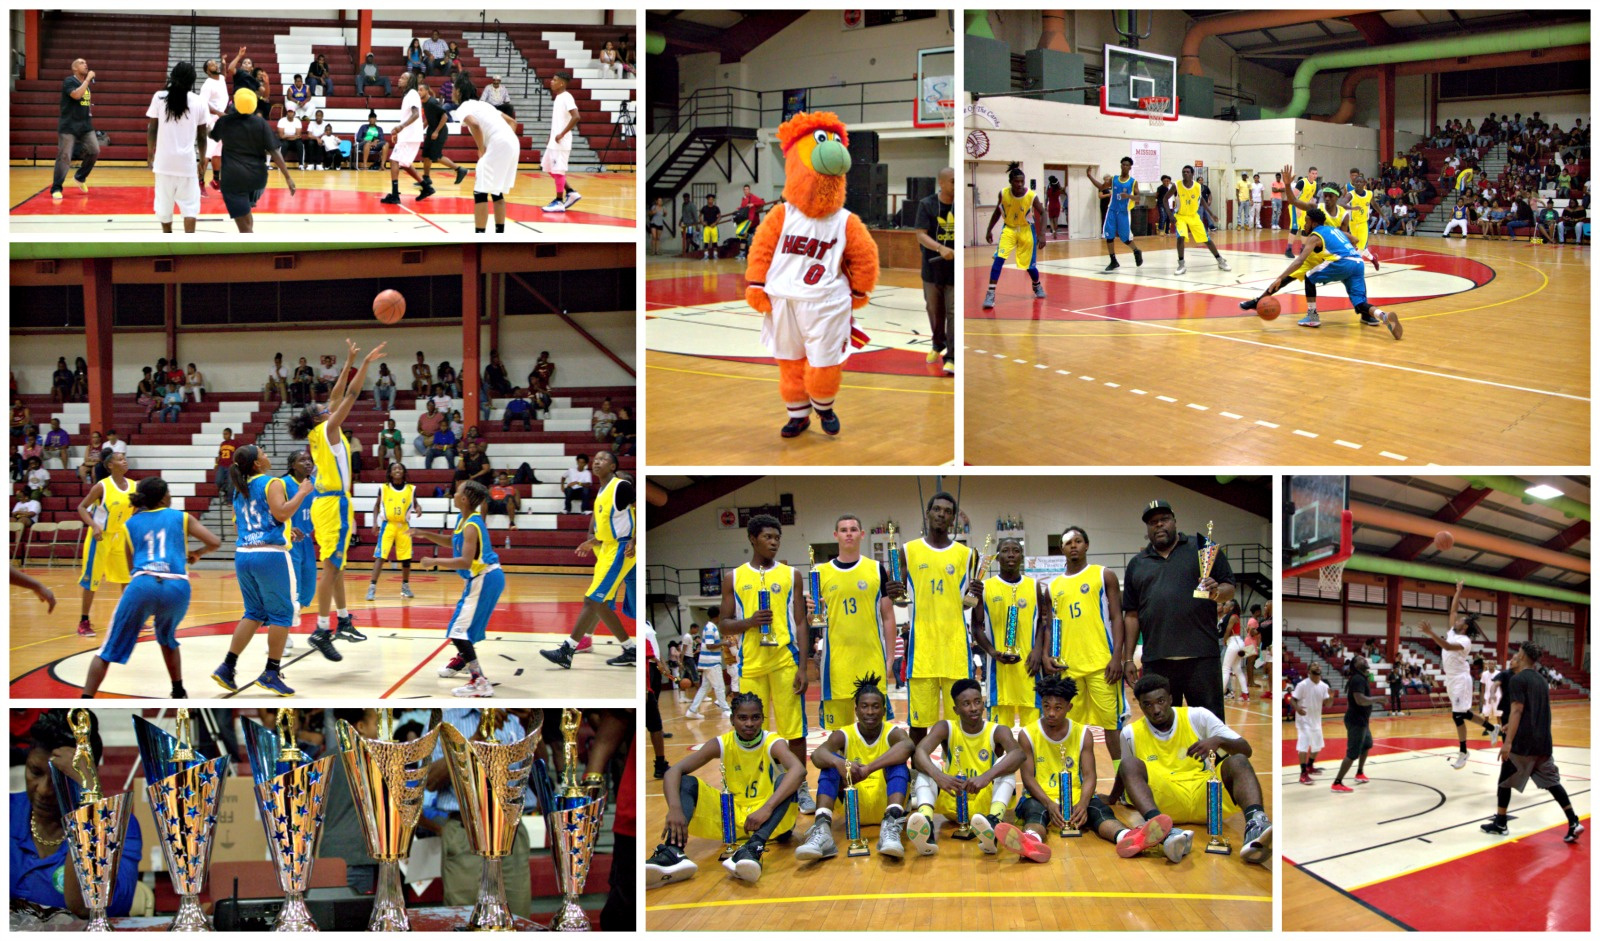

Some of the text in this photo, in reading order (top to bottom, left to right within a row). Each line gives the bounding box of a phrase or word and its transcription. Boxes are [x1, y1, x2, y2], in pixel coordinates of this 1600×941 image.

[1135, 148, 1157, 156] MISSION
[781, 234, 838, 261] HEAT
[803, 263, 826, 286] 0
[394, 506, 402, 516] 13
[1149, 500, 1159, 509] VI
[242, 499, 262, 531] 15
[143, 528, 166, 561] 11
[930, 579, 944, 595] 14
[842, 597, 857, 615] 13
[1069, 601, 1082, 619] 15
[826, 714, 834, 724] 13
[745, 780, 758, 799] 15
[1049, 773, 1057, 788] 6
